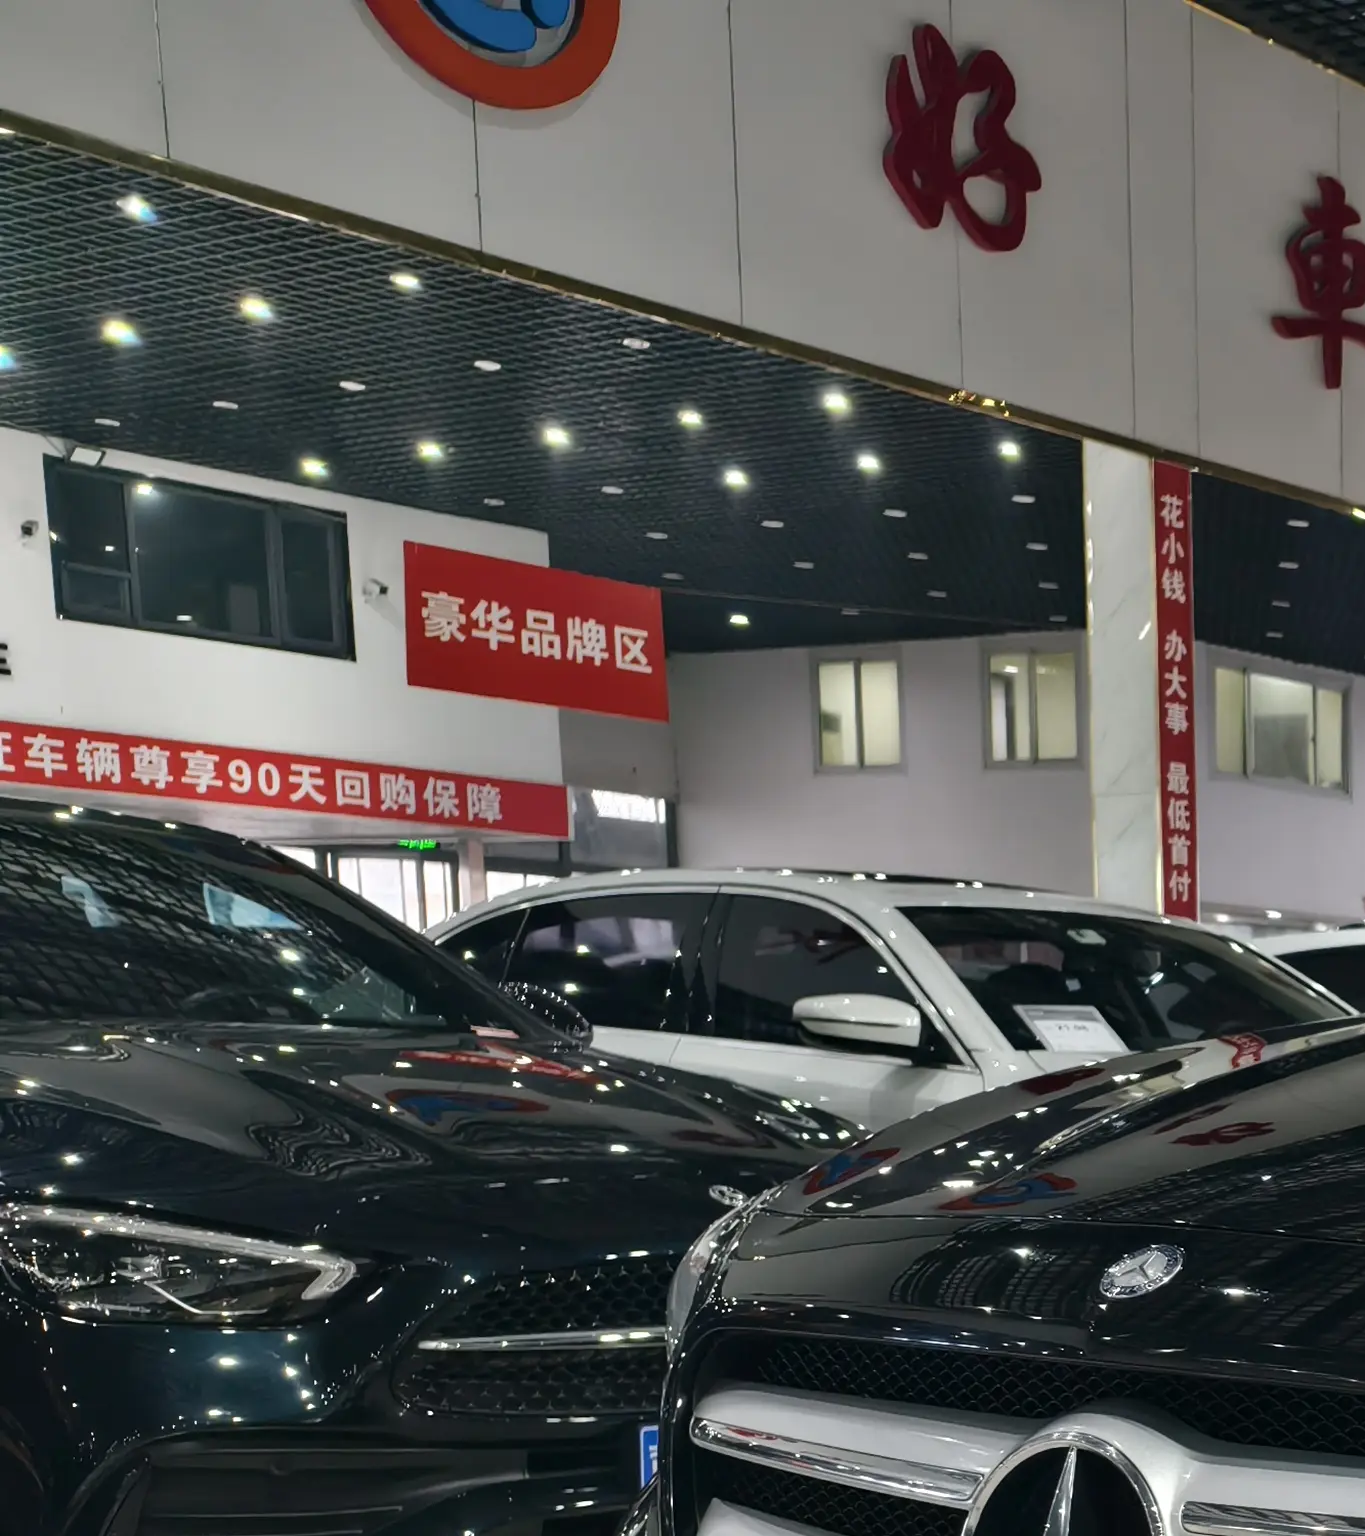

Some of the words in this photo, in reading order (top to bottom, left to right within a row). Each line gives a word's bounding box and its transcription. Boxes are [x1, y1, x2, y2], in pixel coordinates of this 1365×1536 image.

[1160, 495, 1187, 605] 花小钱
[421, 591, 653, 674] 豪华品牌区
[1163, 629, 1189, 735] 办大事
[1166, 761, 1192, 904] 最低首付
